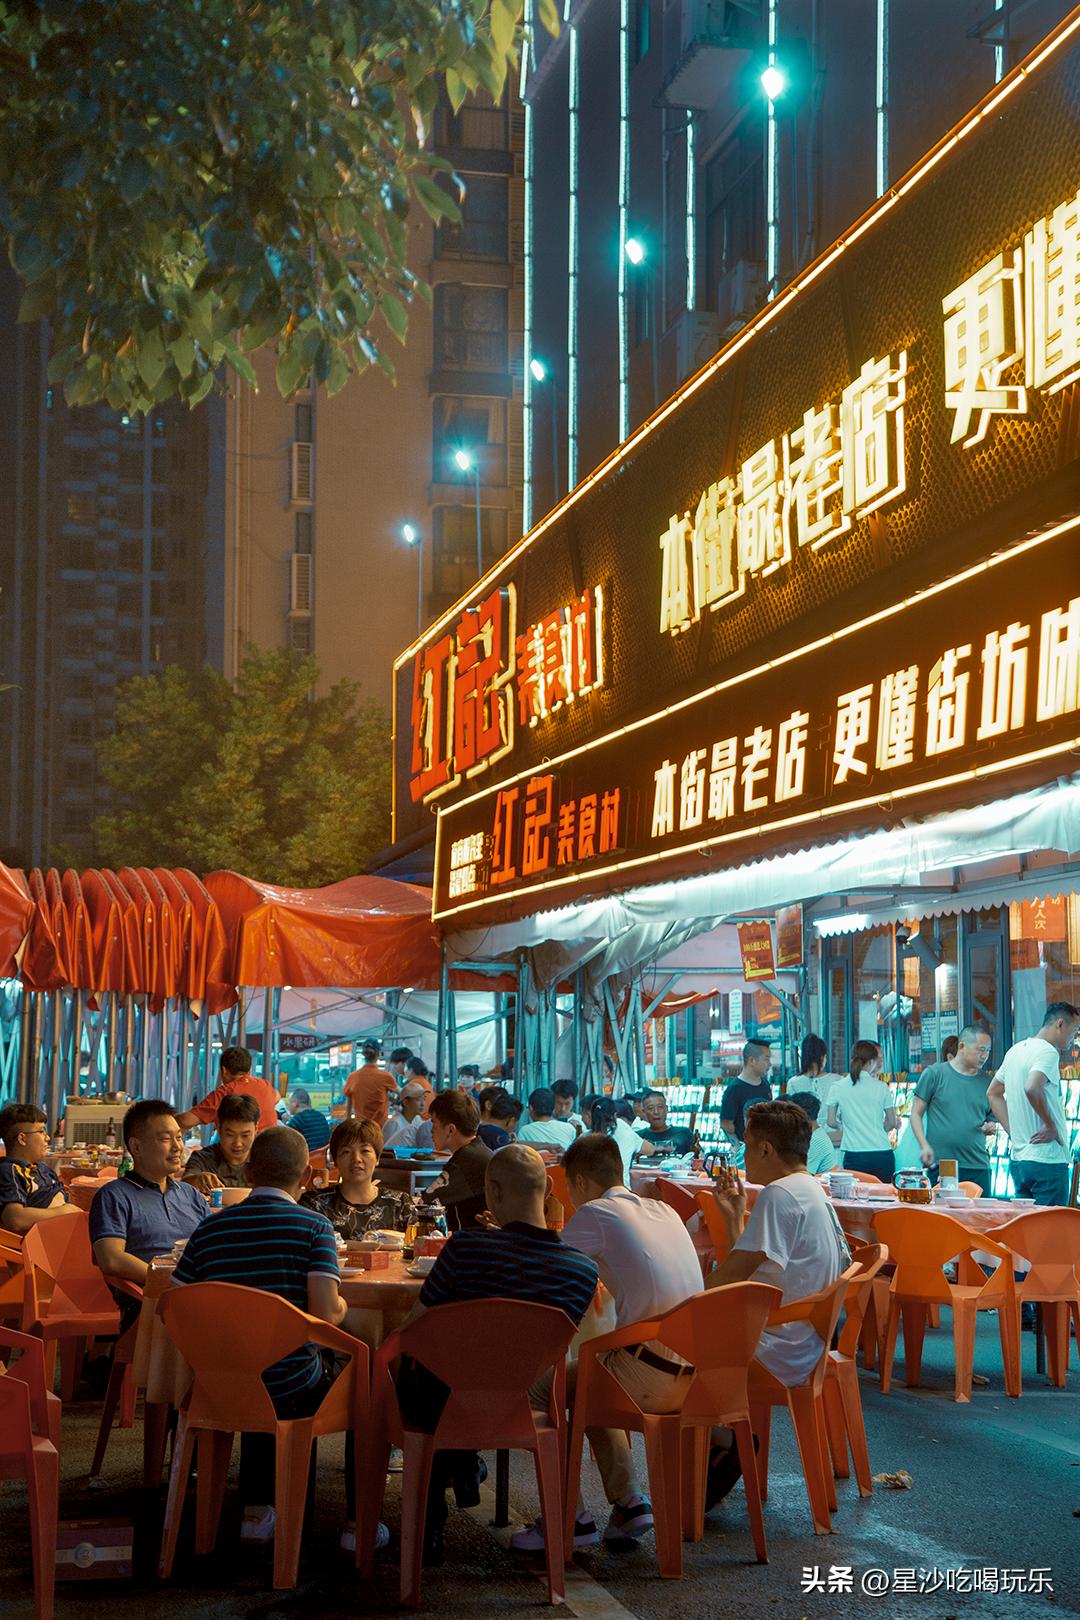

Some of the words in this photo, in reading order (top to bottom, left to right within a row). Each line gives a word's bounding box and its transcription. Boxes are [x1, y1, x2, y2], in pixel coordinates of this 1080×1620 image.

[660, 352, 900, 635] 本街最老店
[557, 787, 620, 866] 美食村
[651, 710, 810, 838] 本街最老店
